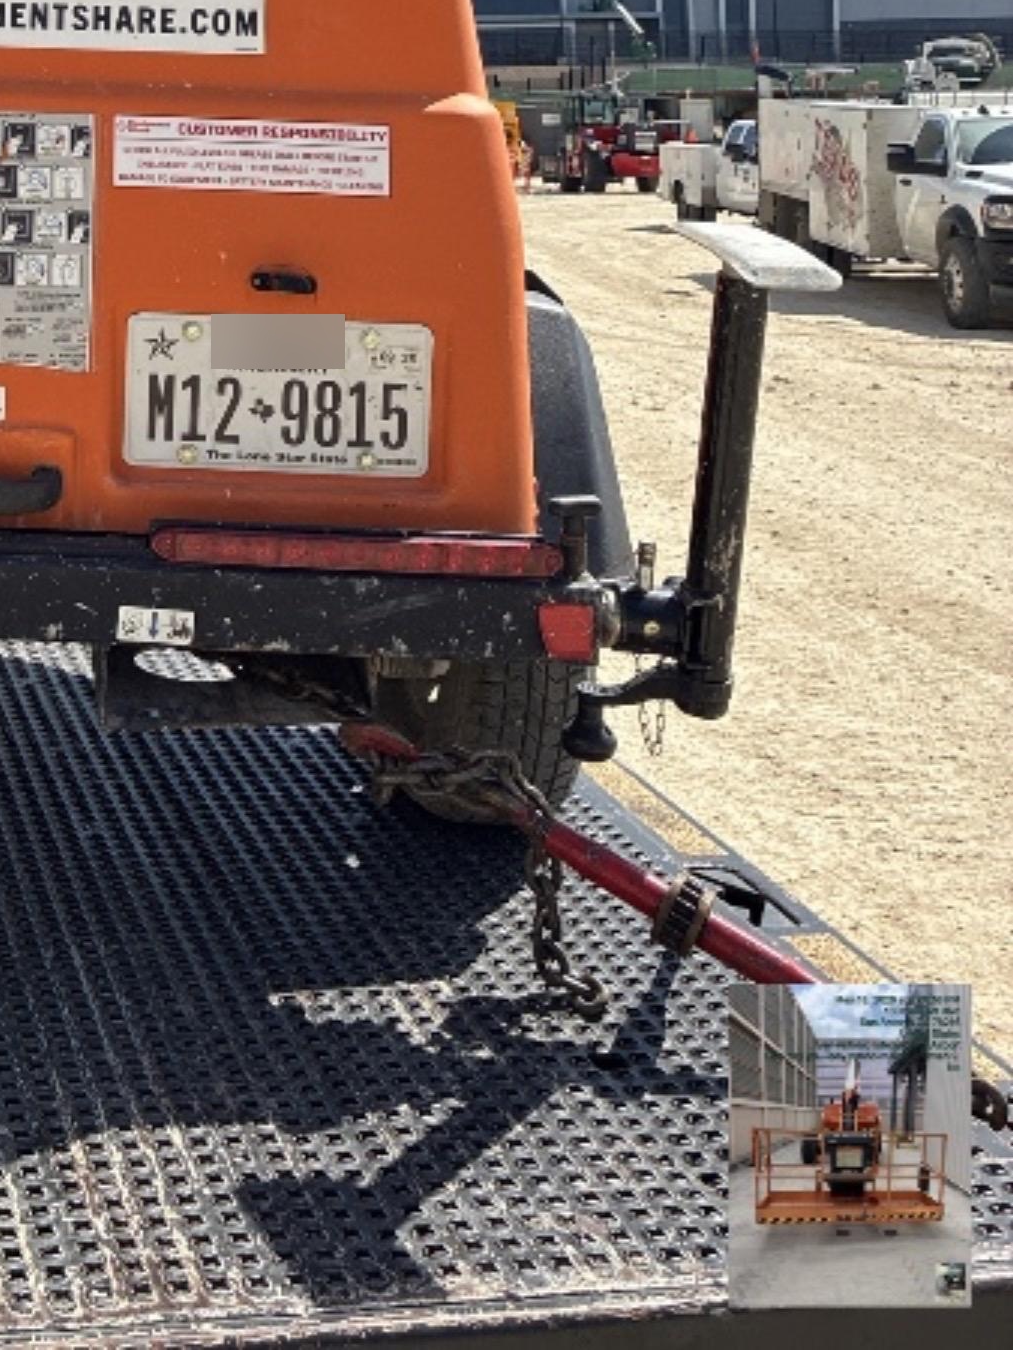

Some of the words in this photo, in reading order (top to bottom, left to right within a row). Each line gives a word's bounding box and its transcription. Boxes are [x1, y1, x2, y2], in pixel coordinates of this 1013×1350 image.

[178, 122, 258, 139] CUSTOMER
[147, 373, 242, 445] M12
[280, 378, 410, 450] 9815
[206, 449, 231, 460] The
